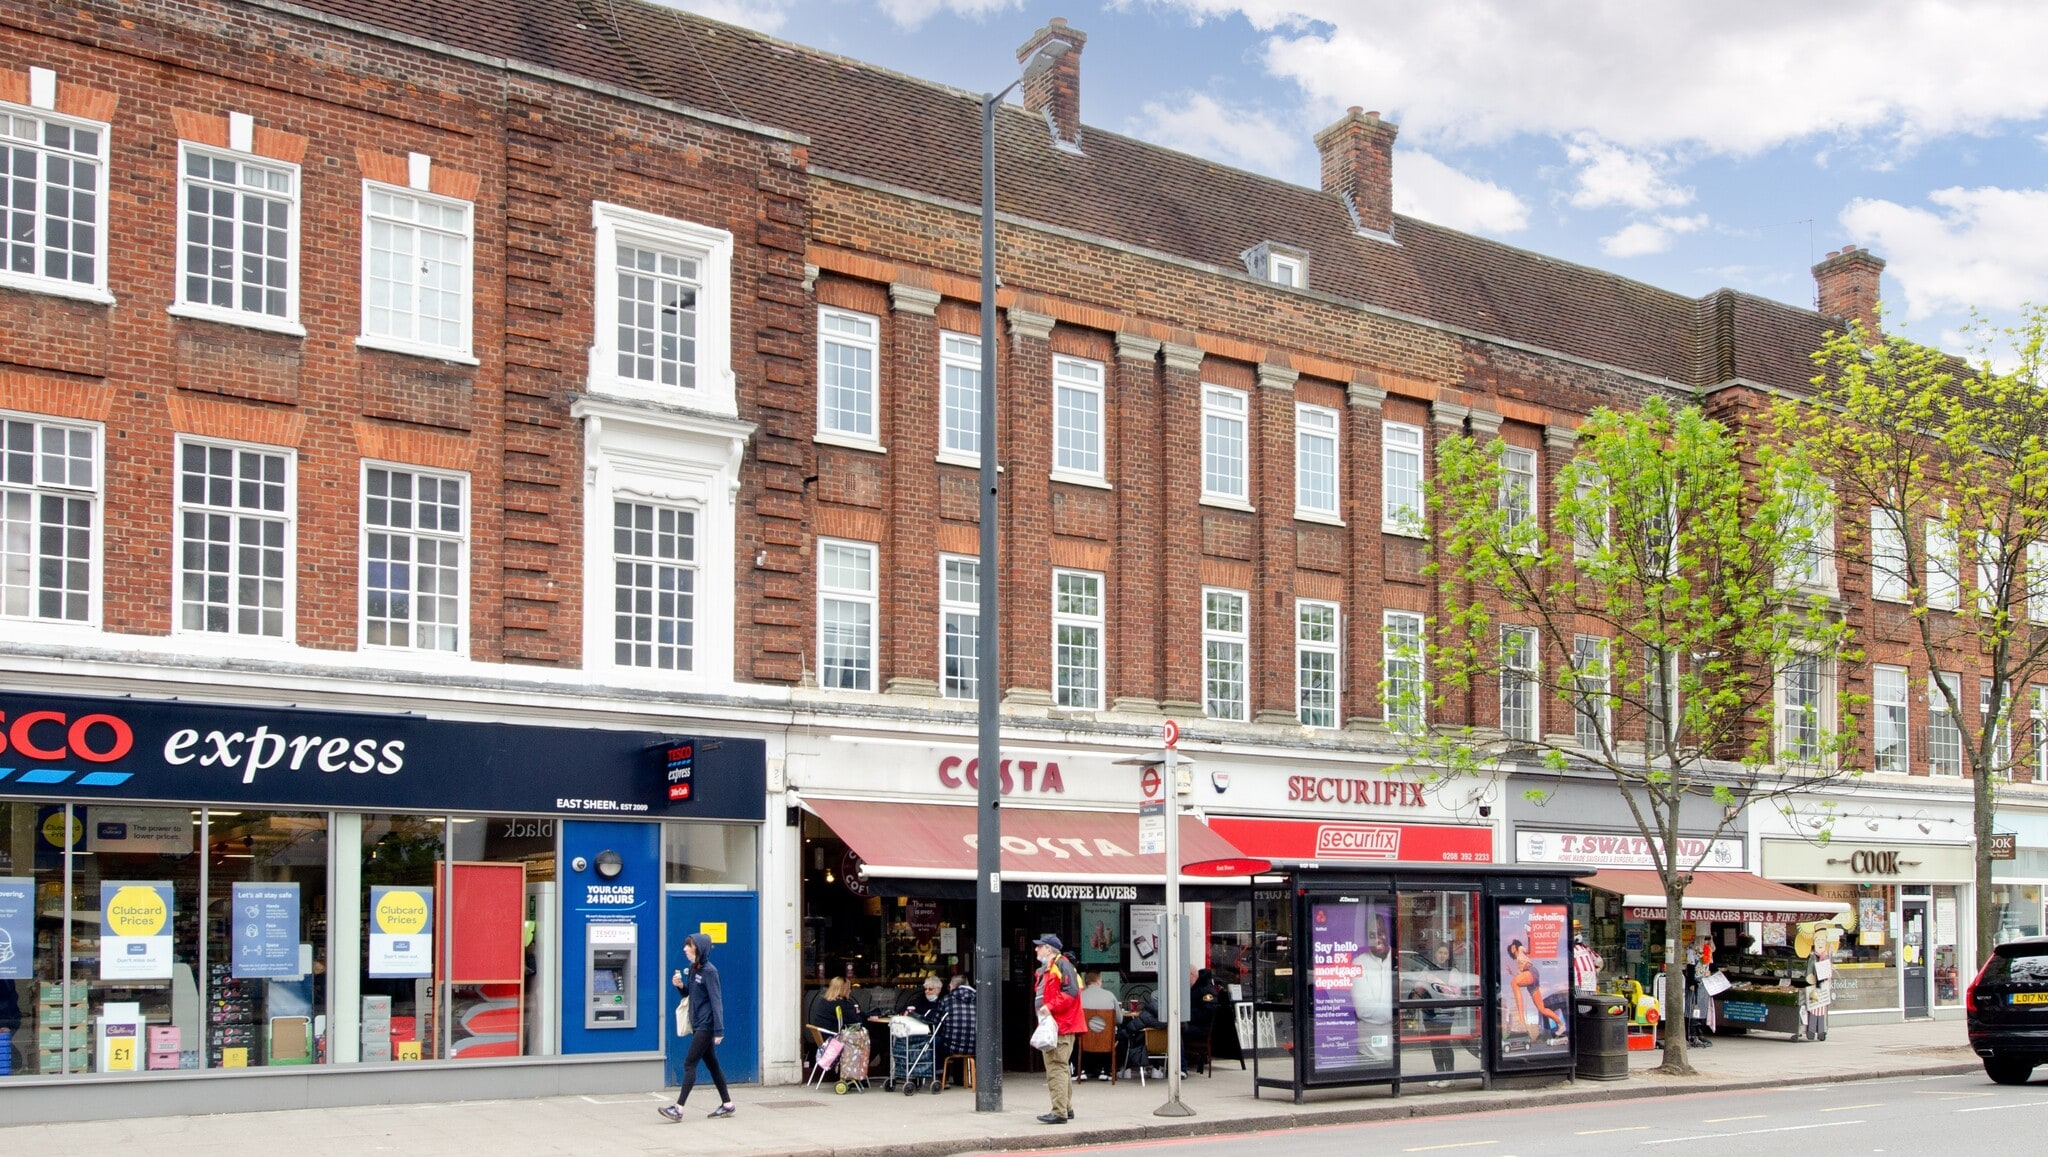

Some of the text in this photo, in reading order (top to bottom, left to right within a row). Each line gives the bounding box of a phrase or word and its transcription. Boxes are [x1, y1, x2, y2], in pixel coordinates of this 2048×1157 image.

[163, 725, 405, 784] express
[667, 746, 692, 761] TESCO
[668, 767, 691, 783] express
[1288, 776, 1427, 807] SECURIFIX
[556, 798, 581, 808] EAST
[583, 799, 619, 810] SHEEN.
[149, 826, 172, 834] power
[1321, 829, 1395, 849] securifix
[1442, 852, 1489, 861] 0208 392 2233
[1586, 855, 1608, 863] SAUSAGES
[1851, 850, 1901, 875] COOK
[0, 891, 25, 899] overing,
[586, 885, 635, 894] YOUR CASH
[1027, 884, 1137, 900] FOR COFFEE LOVERS
[586, 895, 634, 904] 24 HOURS
[112, 905, 162, 915] Clubcard
[380, 906, 424, 915] Clubcard
[120, 916, 154, 926] Prices
[387, 916, 418, 924] Prices
[1529, 912, 1565, 922] Ride-hailing
[1690, 910, 1740, 921] SAUSAGES
[1743, 911, 1764, 921] PIES
[1766, 913, 1774, 921] &
[1775, 913, 1797, 922] FINE
[1532, 924, 1544, 932] you
[1533, 931, 1551, 939] count
[1315, 941, 1358, 954] Say hello
[1315, 953, 1325, 964] to
[1326, 955, 1333, 964] a
[1315, 966, 1362, 978] mortgage
[1315, 977, 1353, 990] deposit.
[114, 1049, 129, 1060] £1
